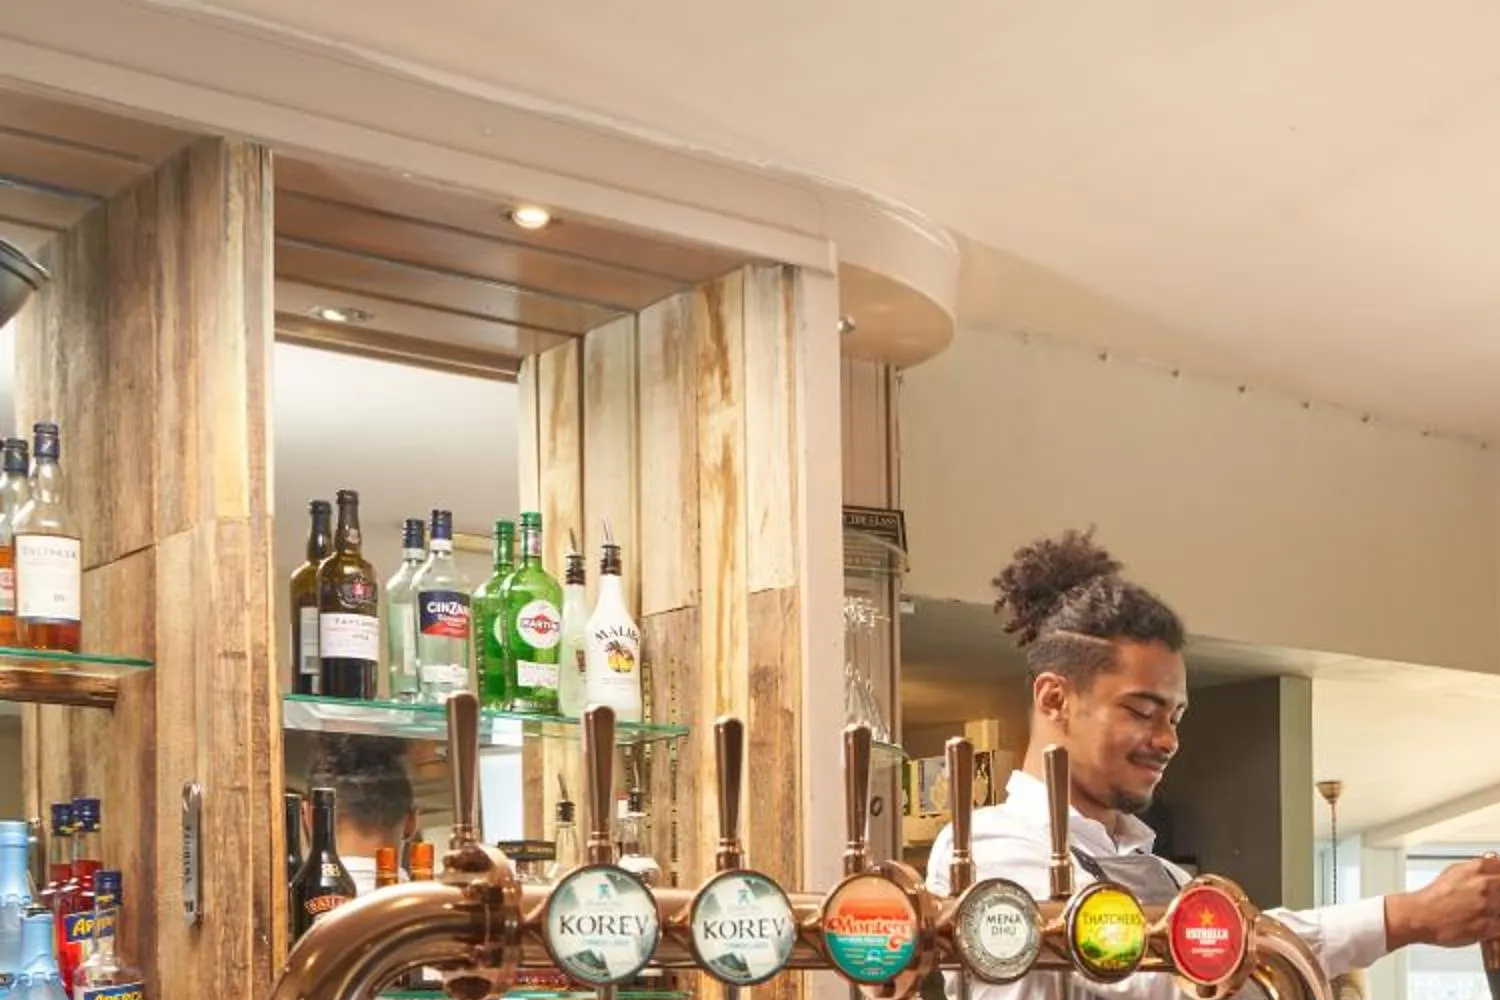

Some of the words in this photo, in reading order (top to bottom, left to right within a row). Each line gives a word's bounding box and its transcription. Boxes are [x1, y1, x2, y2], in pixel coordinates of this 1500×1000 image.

[559, 915, 649, 936] KOREV
[986, 914, 1021, 924] MENA
[1083, 912, 1141, 925] THATCHERS
[703, 917, 785, 940] KOREV
